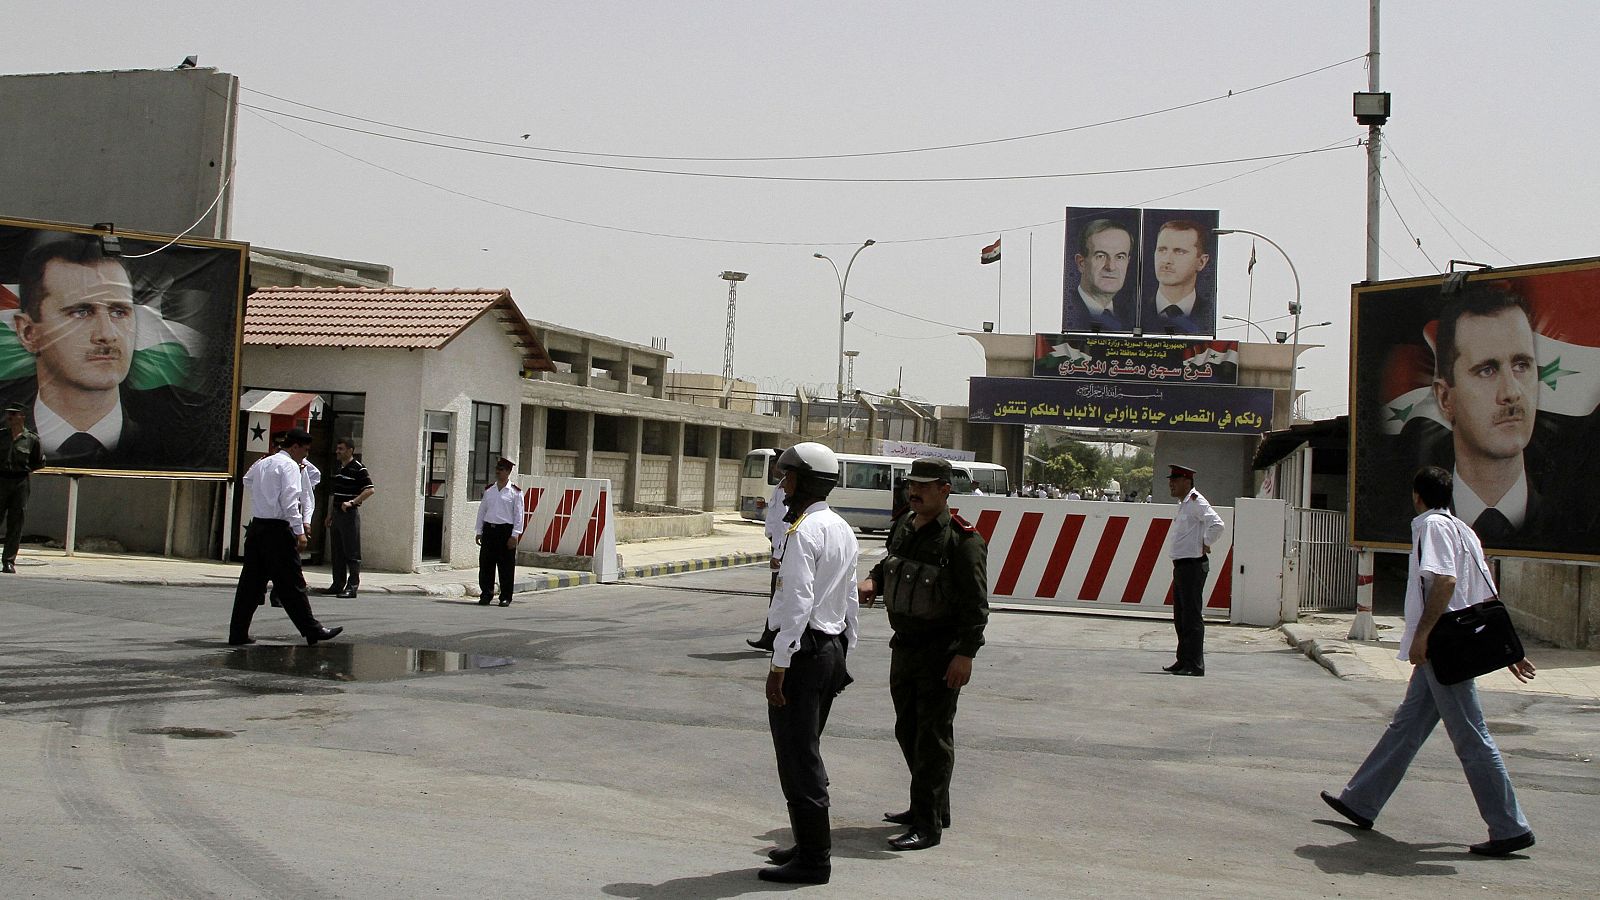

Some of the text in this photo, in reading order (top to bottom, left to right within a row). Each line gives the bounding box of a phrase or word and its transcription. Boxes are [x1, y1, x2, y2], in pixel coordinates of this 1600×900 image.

[1106, 348, 1119, 357] دمشق
[1144, 341, 1162, 350] العربية
[1059, 358, 1213, 381] فرع سجن دمشق المركزي
[993, 400, 1027, 417] تتقون
[1030, 403, 1060, 418] لعلكم
[1063, 402, 1101, 421] الألباب
[1141, 407, 1167, 424] حياة
[1169, 409, 1215, 425] القصاص
[1217, 409, 1232, 430] في
[1235, 411, 1263, 428] ولكم
